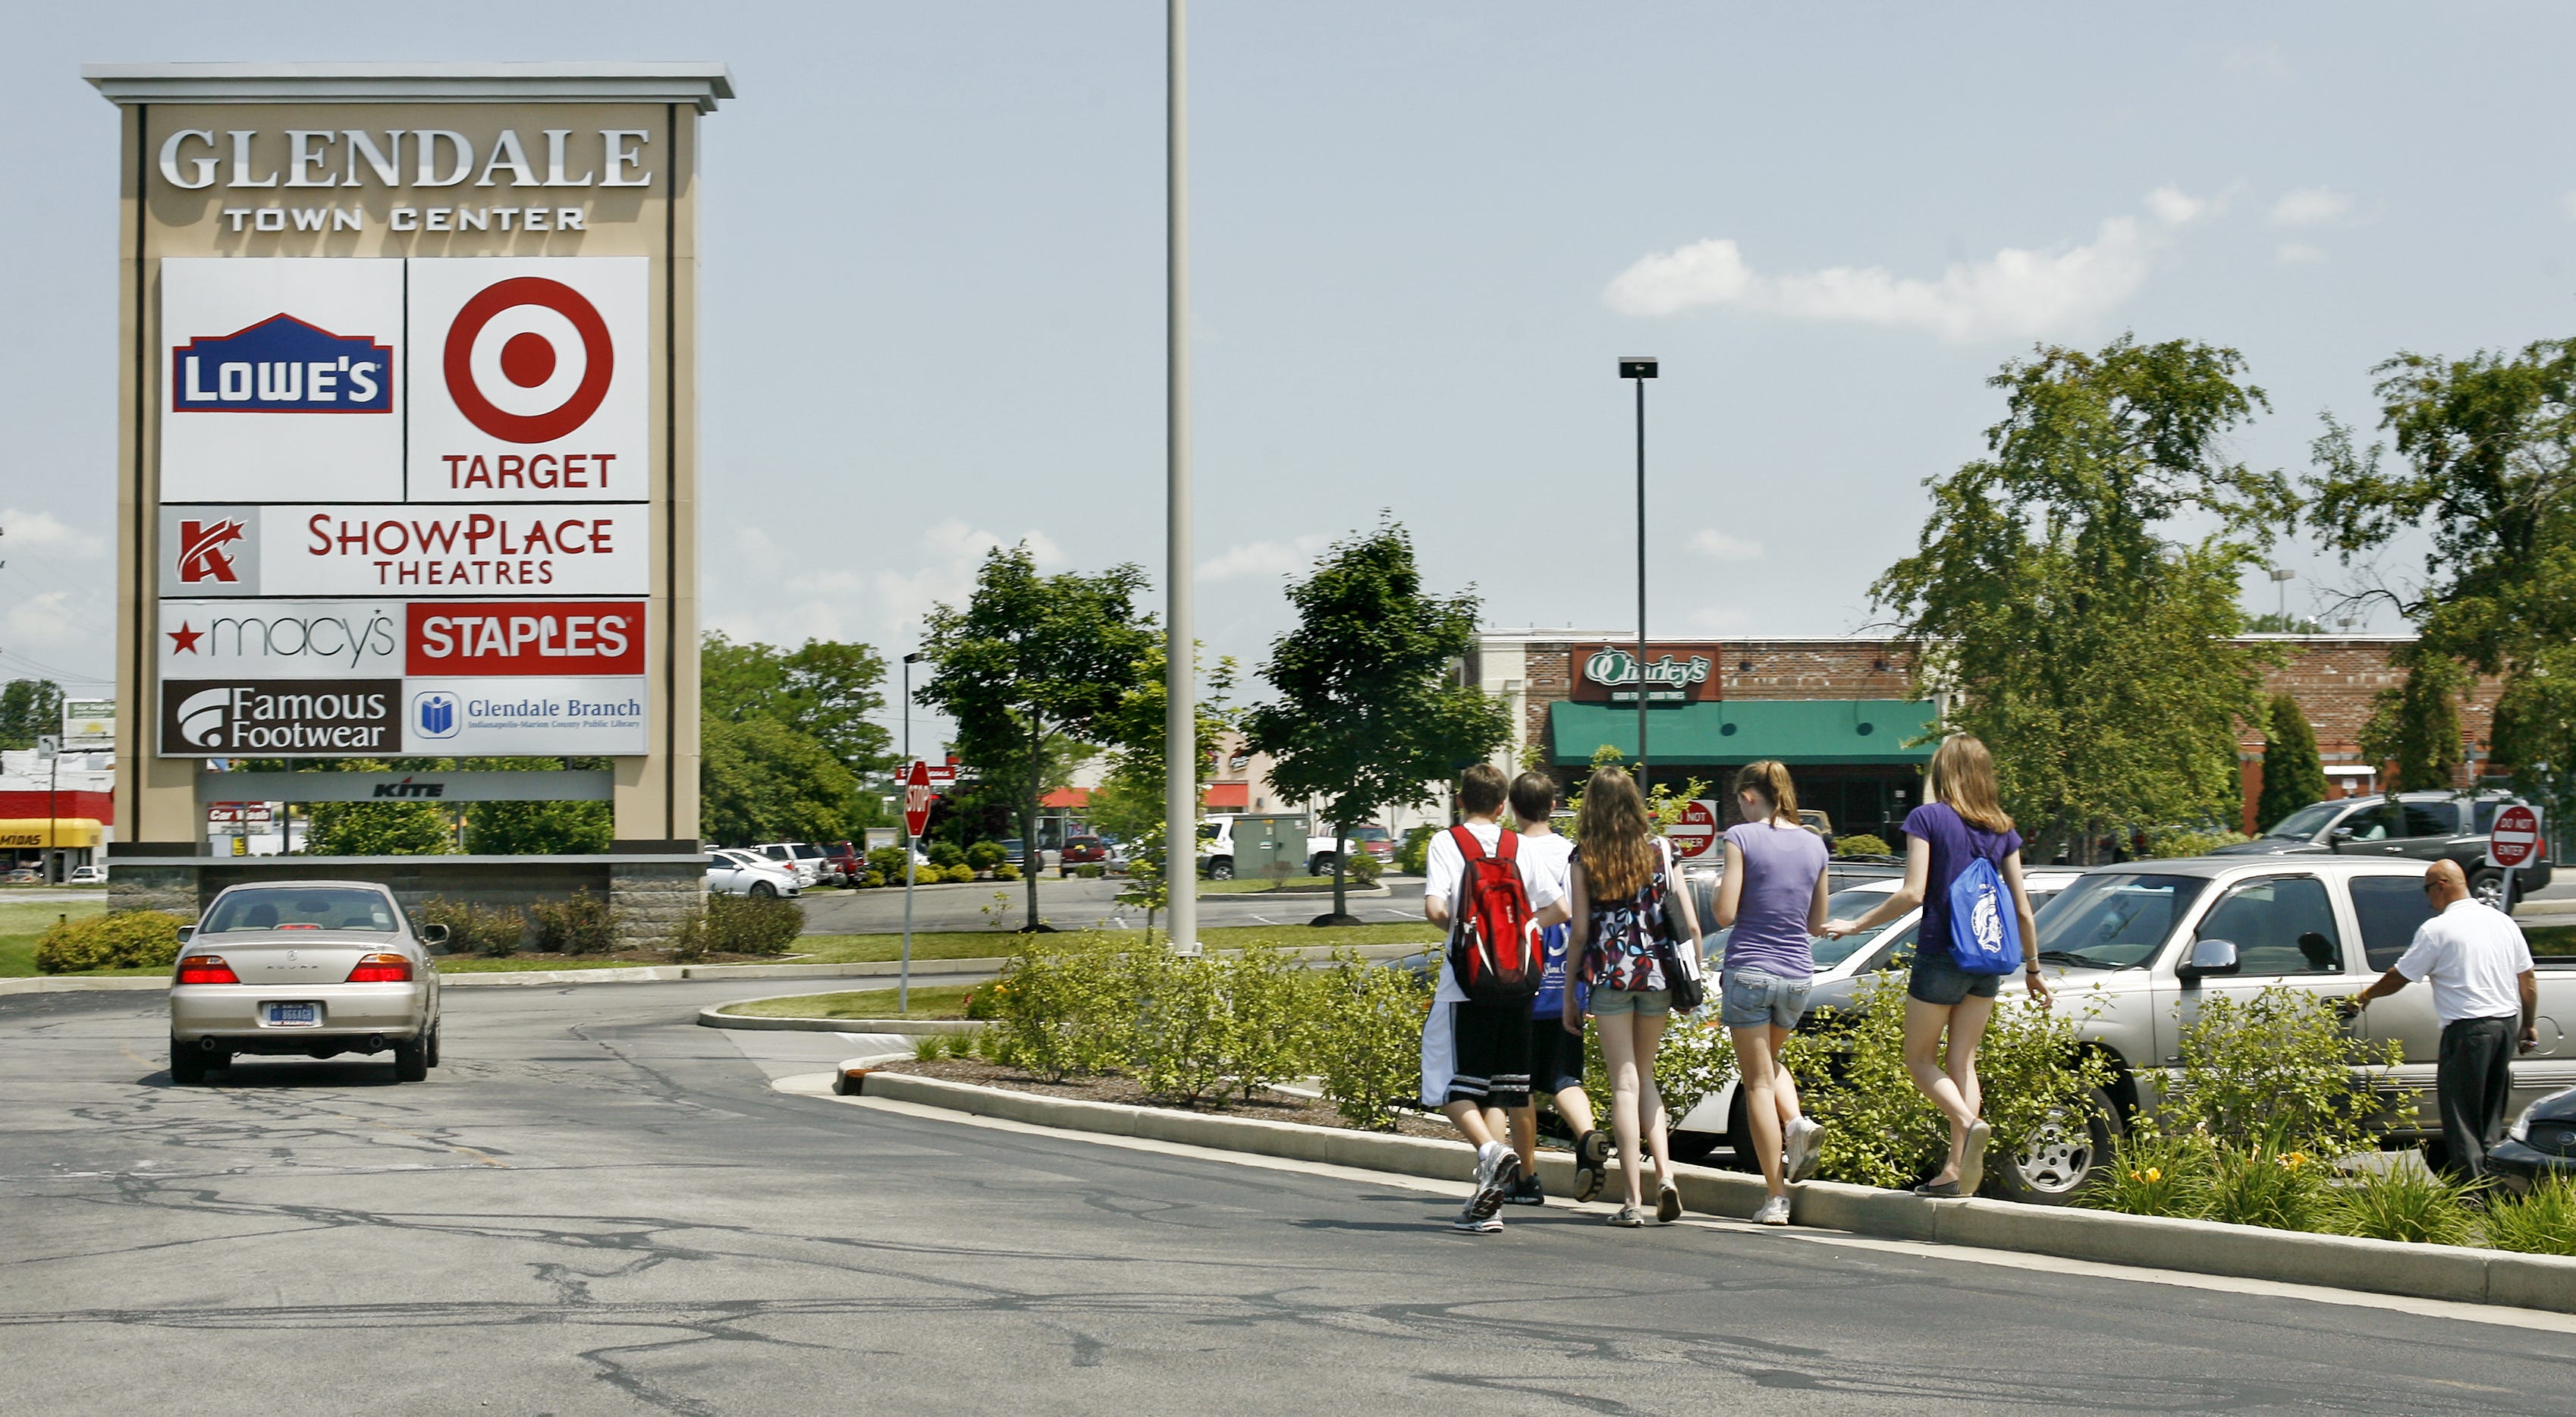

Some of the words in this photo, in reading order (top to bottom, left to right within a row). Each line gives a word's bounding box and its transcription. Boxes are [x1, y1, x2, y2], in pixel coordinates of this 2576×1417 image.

[159, 128, 652, 189] GLENDALE
[224, 209, 363, 231] TOWN
[390, 208, 586, 231] CENTER
[185, 356, 379, 403] LOWE'S
[442, 454, 616, 489] TARGET
[374, 561, 553, 585] THEATRES
[212, 609, 395, 669] macy's
[422, 614, 629, 658] STAPLES
[231, 687, 387, 721] Famous
[468, 699, 560, 717] Glendale
[567, 699, 642, 716] Branch
[231, 721, 386, 747] Footwear
[551, 721, 580, 729] County
[611, 720, 640, 728] Library
[373, 777, 445, 797] KITE
[906, 784, 929, 812] STOP
[209, 809, 233, 821] Car
[1686, 812, 1706, 822] NOT
[2500, 818, 2513, 828] DO
[2515, 818, 2534, 829] NOT
[0, 834, 42, 845] MIDAS
[2497, 844, 2525, 856] ENTER
